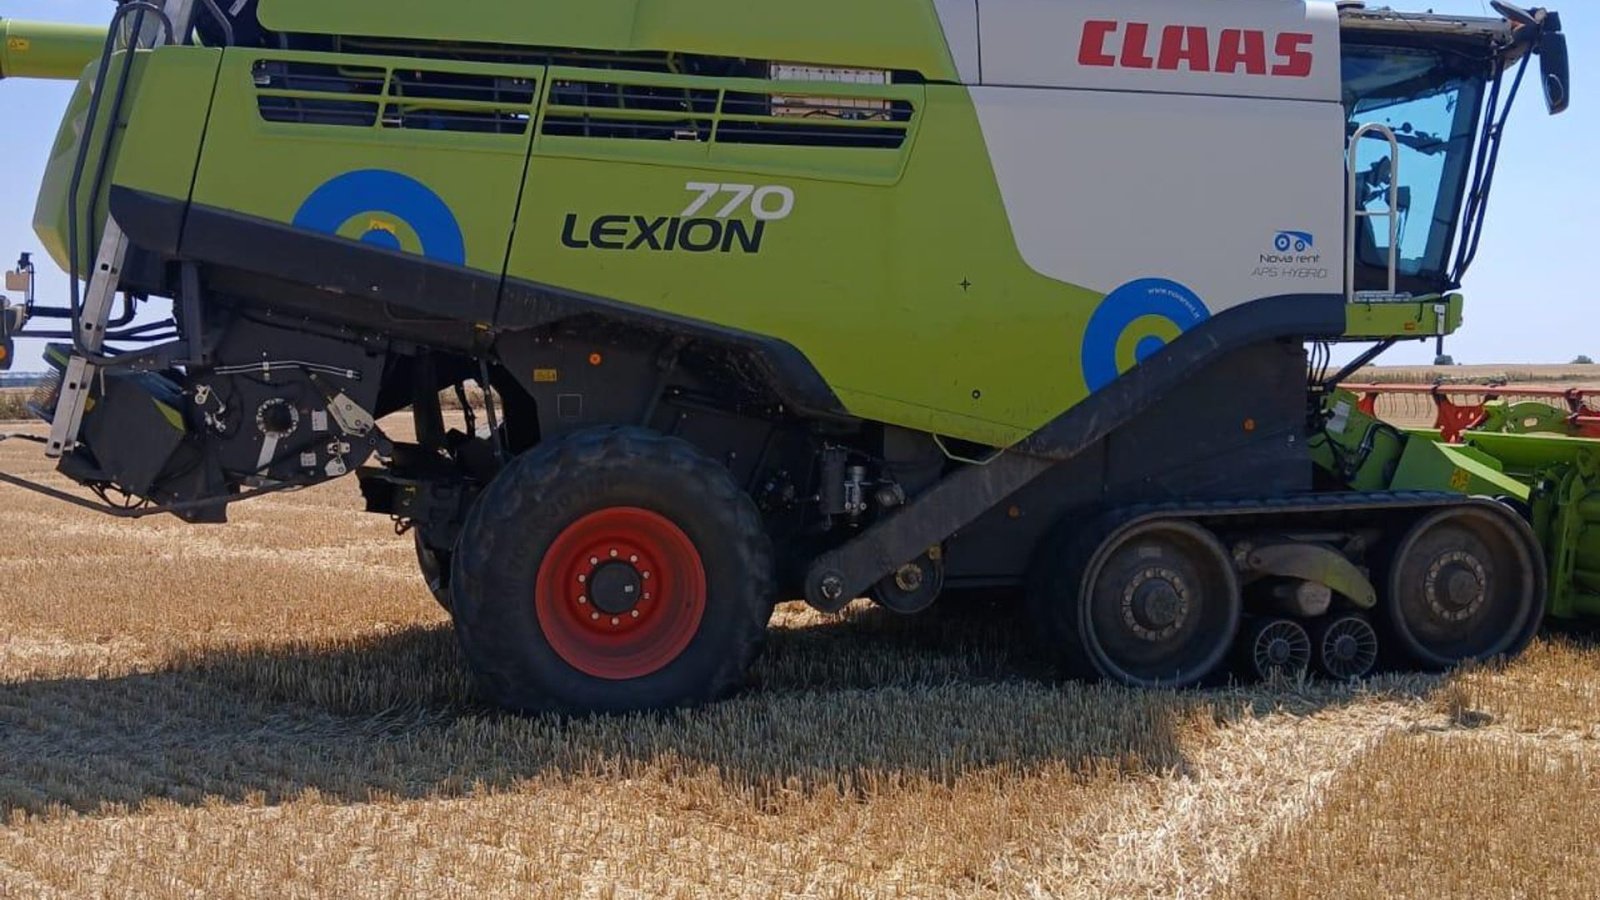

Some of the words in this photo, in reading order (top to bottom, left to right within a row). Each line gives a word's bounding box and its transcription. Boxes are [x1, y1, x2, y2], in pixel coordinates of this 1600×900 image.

[1077, 20, 1313, 77] CLAAS
[681, 182, 795, 220] 770
[561, 213, 765, 253] LEXION
[1251, 267, 1278, 277] APS
[1282, 268, 1327, 278] HYBRID
[1296, 254, 1320, 263] rent
